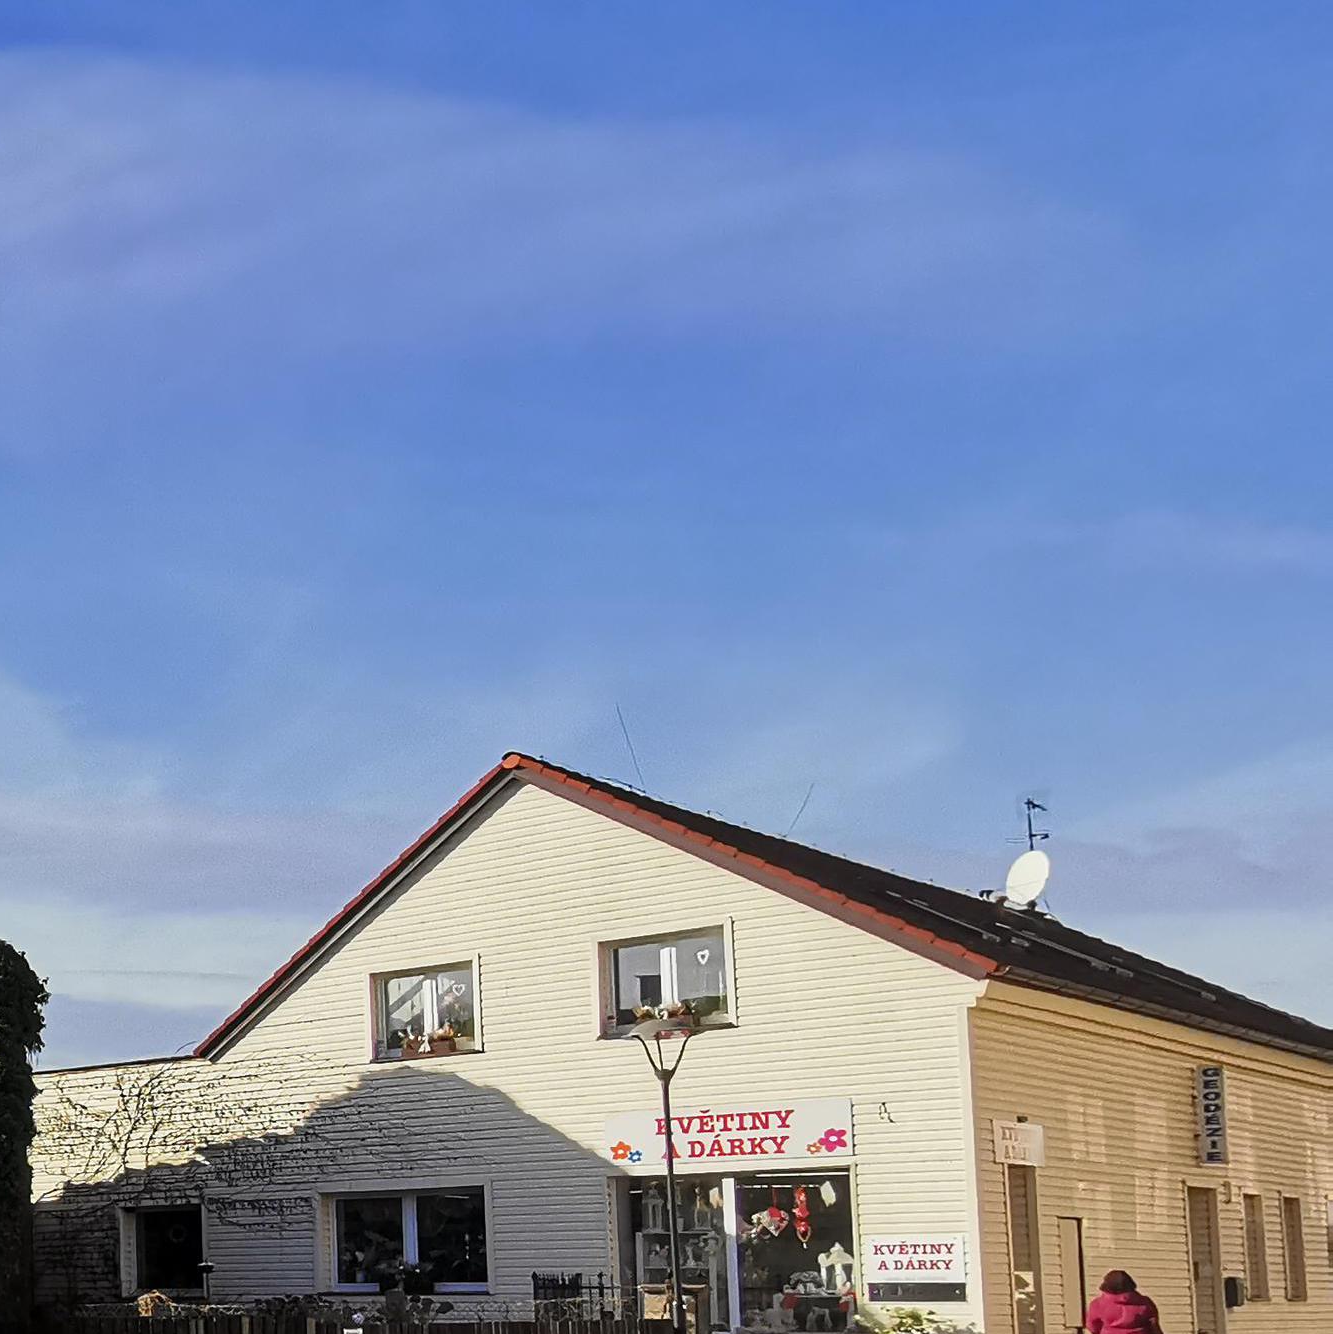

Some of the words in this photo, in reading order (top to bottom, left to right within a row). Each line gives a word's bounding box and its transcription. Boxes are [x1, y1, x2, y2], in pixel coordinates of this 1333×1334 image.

[688, 1134, 790, 1158] DÁRKY
[873, 1241, 955, 1256] KVĚTINY
[877, 1259, 890, 1271] A
[893, 1256, 953, 1271] DÁRKY
